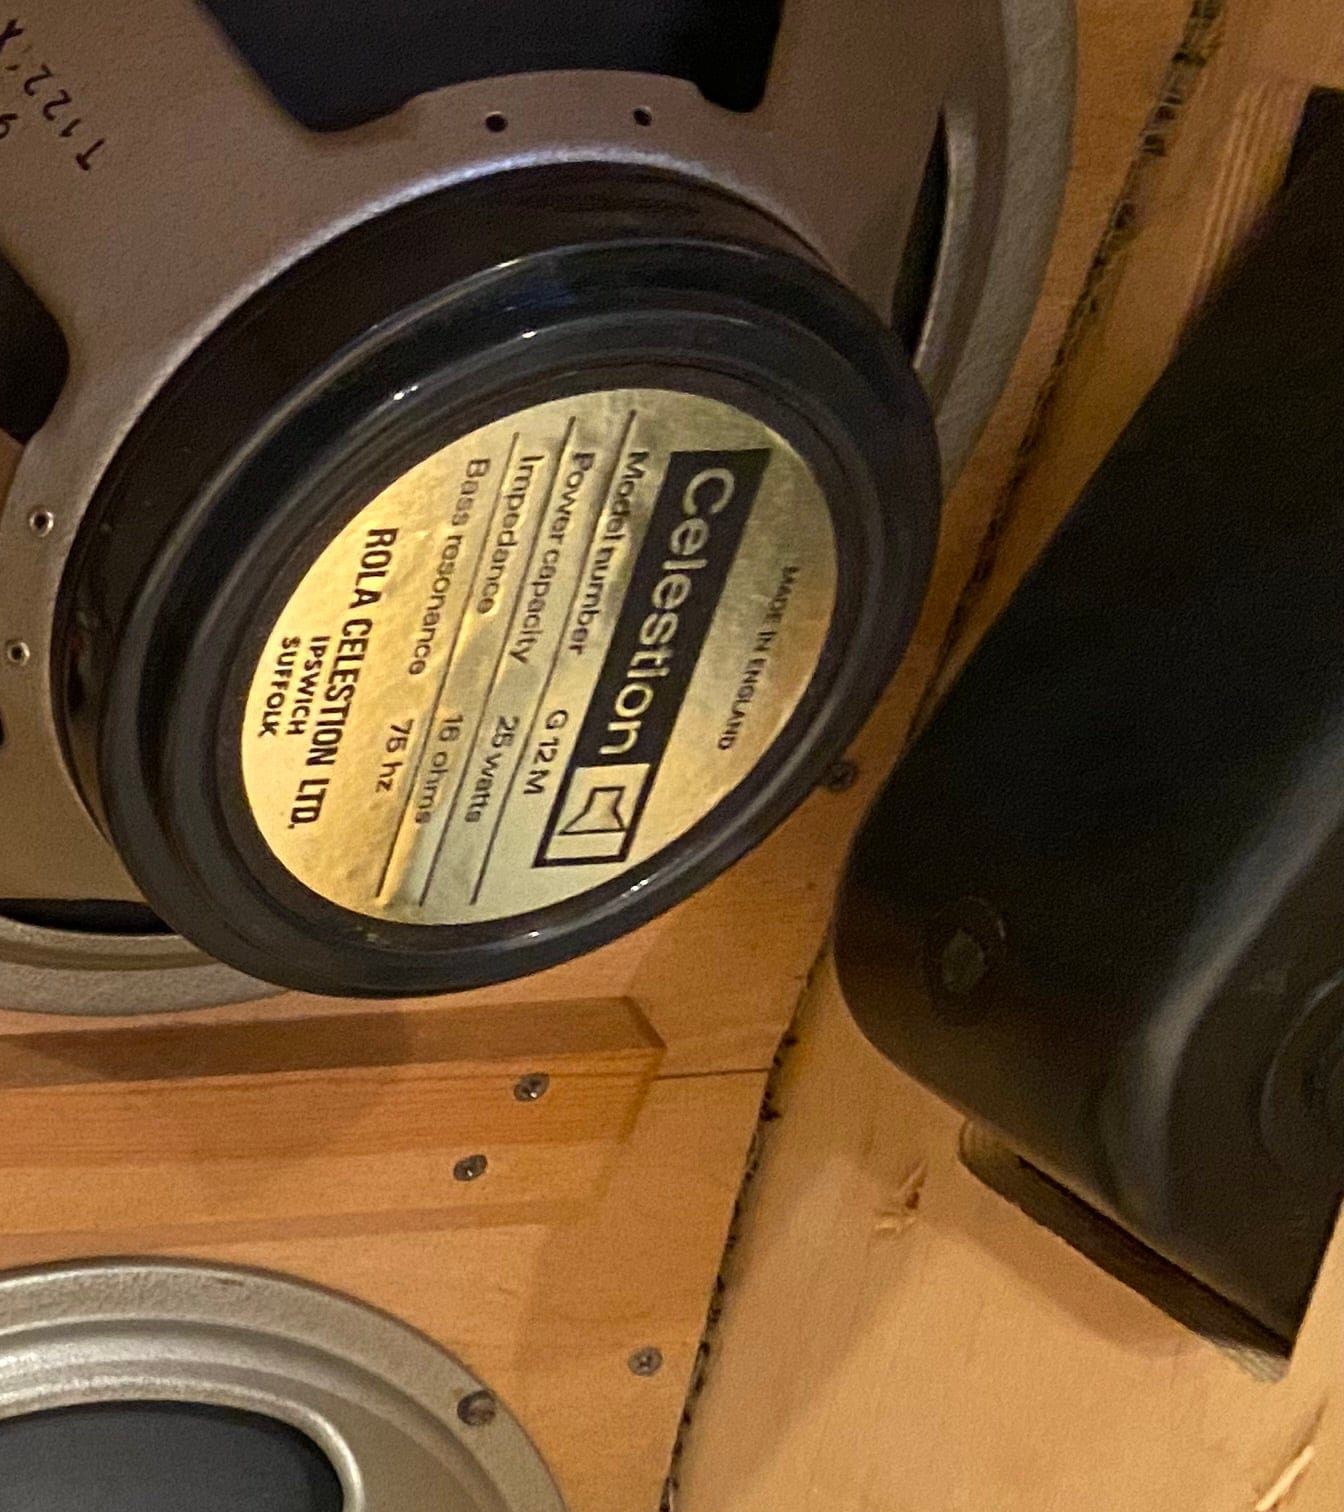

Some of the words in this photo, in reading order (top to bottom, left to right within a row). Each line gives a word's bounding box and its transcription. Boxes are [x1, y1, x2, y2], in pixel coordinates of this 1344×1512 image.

[451, 458, 491, 527] Bass
[548, 451, 596, 540] Power
[604, 451, 649, 541] Model
[349, 527, 399, 610] ROLA
[476, 455, 544, 614] Impedance
[409, 533, 464, 675] resonance
[510, 548, 560, 665] capacity
[570, 547, 614, 655] number
[599, 467, 735, 755] Celestion
[762, 565, 798, 624] MADE
[757, 630, 777, 653] IN
[258, 637, 301, 738] SUFFOLK
[286, 636, 331, 735] IPSWICH
[306, 618, 372, 766] CELESTION
[545, 709, 569, 730] G
[717, 657, 768, 751] ENGLAND
[385, 719, 414, 754] 75
[439, 714, 463, 742] 16
[494, 715, 521, 748] 25
[288, 778, 331, 829] LTD.
[376, 760, 404, 794] hz
[414, 749, 449, 825] ohms
[464, 752, 508, 824] watts
